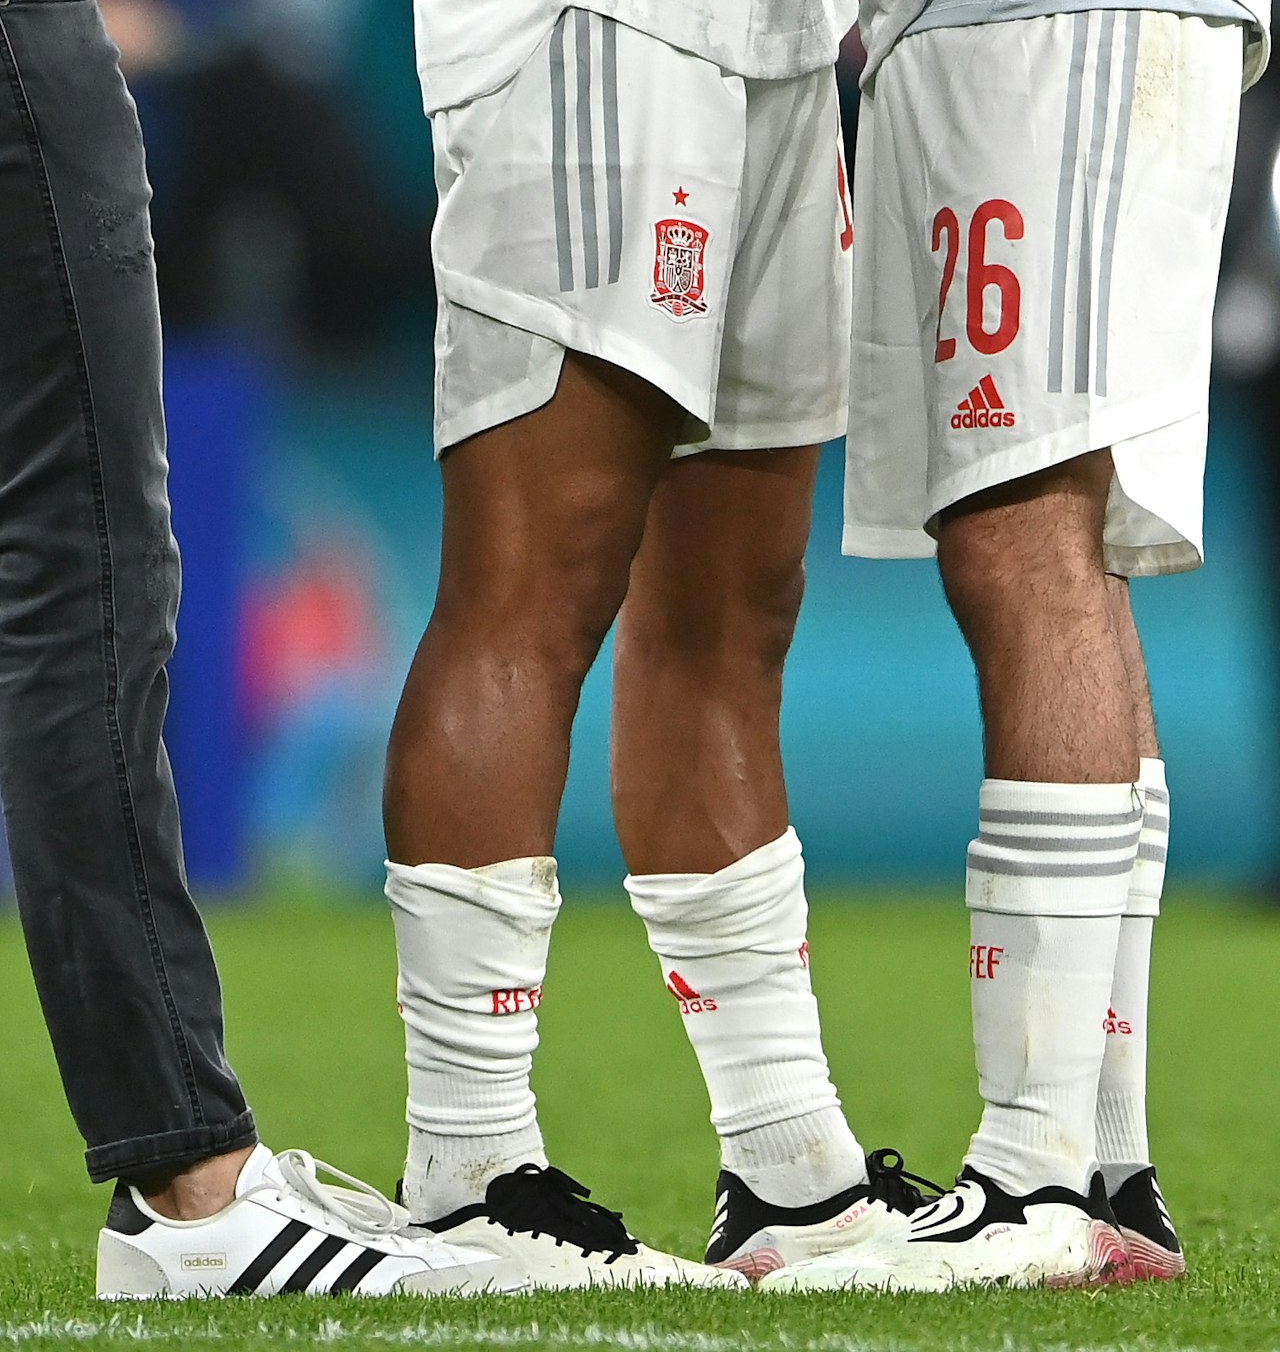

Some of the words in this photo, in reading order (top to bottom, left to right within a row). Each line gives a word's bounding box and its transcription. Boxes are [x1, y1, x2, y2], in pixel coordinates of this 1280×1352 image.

[931, 198, 1024, 363] 26
[951, 408, 1015, 429] adidas
[835, 1205, 867, 1229] COPA
[183, 1257, 223, 1267] adidas
